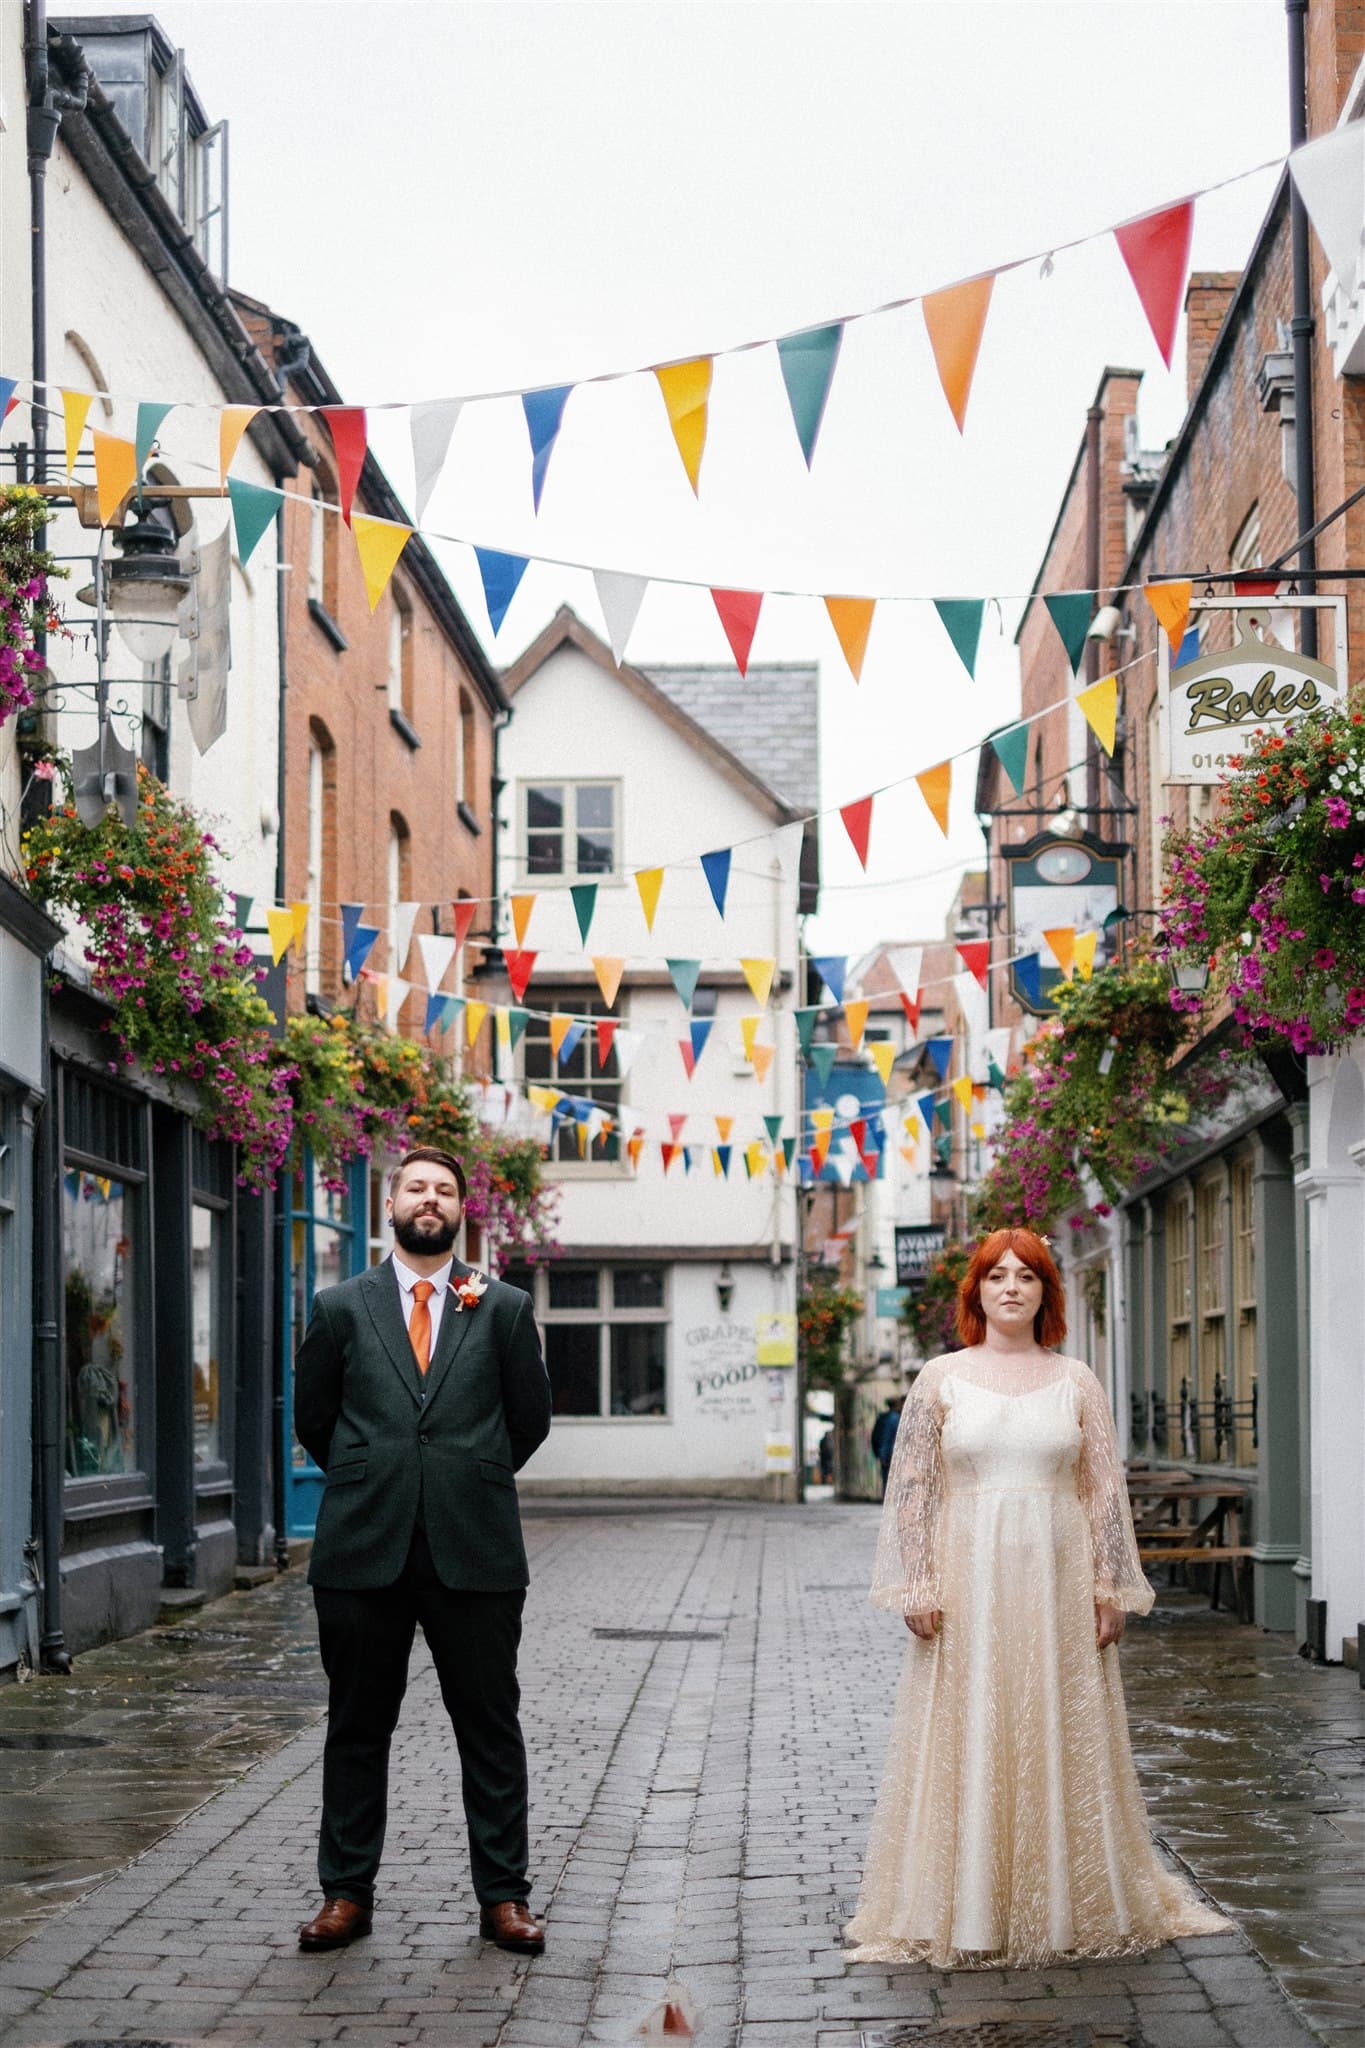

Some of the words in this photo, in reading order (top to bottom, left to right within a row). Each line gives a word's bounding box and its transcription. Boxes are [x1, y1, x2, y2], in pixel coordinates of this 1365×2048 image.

[1187, 671, 1321, 728] Robes
[898, 1234, 944, 1250] AVANT
[696, 1364, 757, 1396] FOOD
